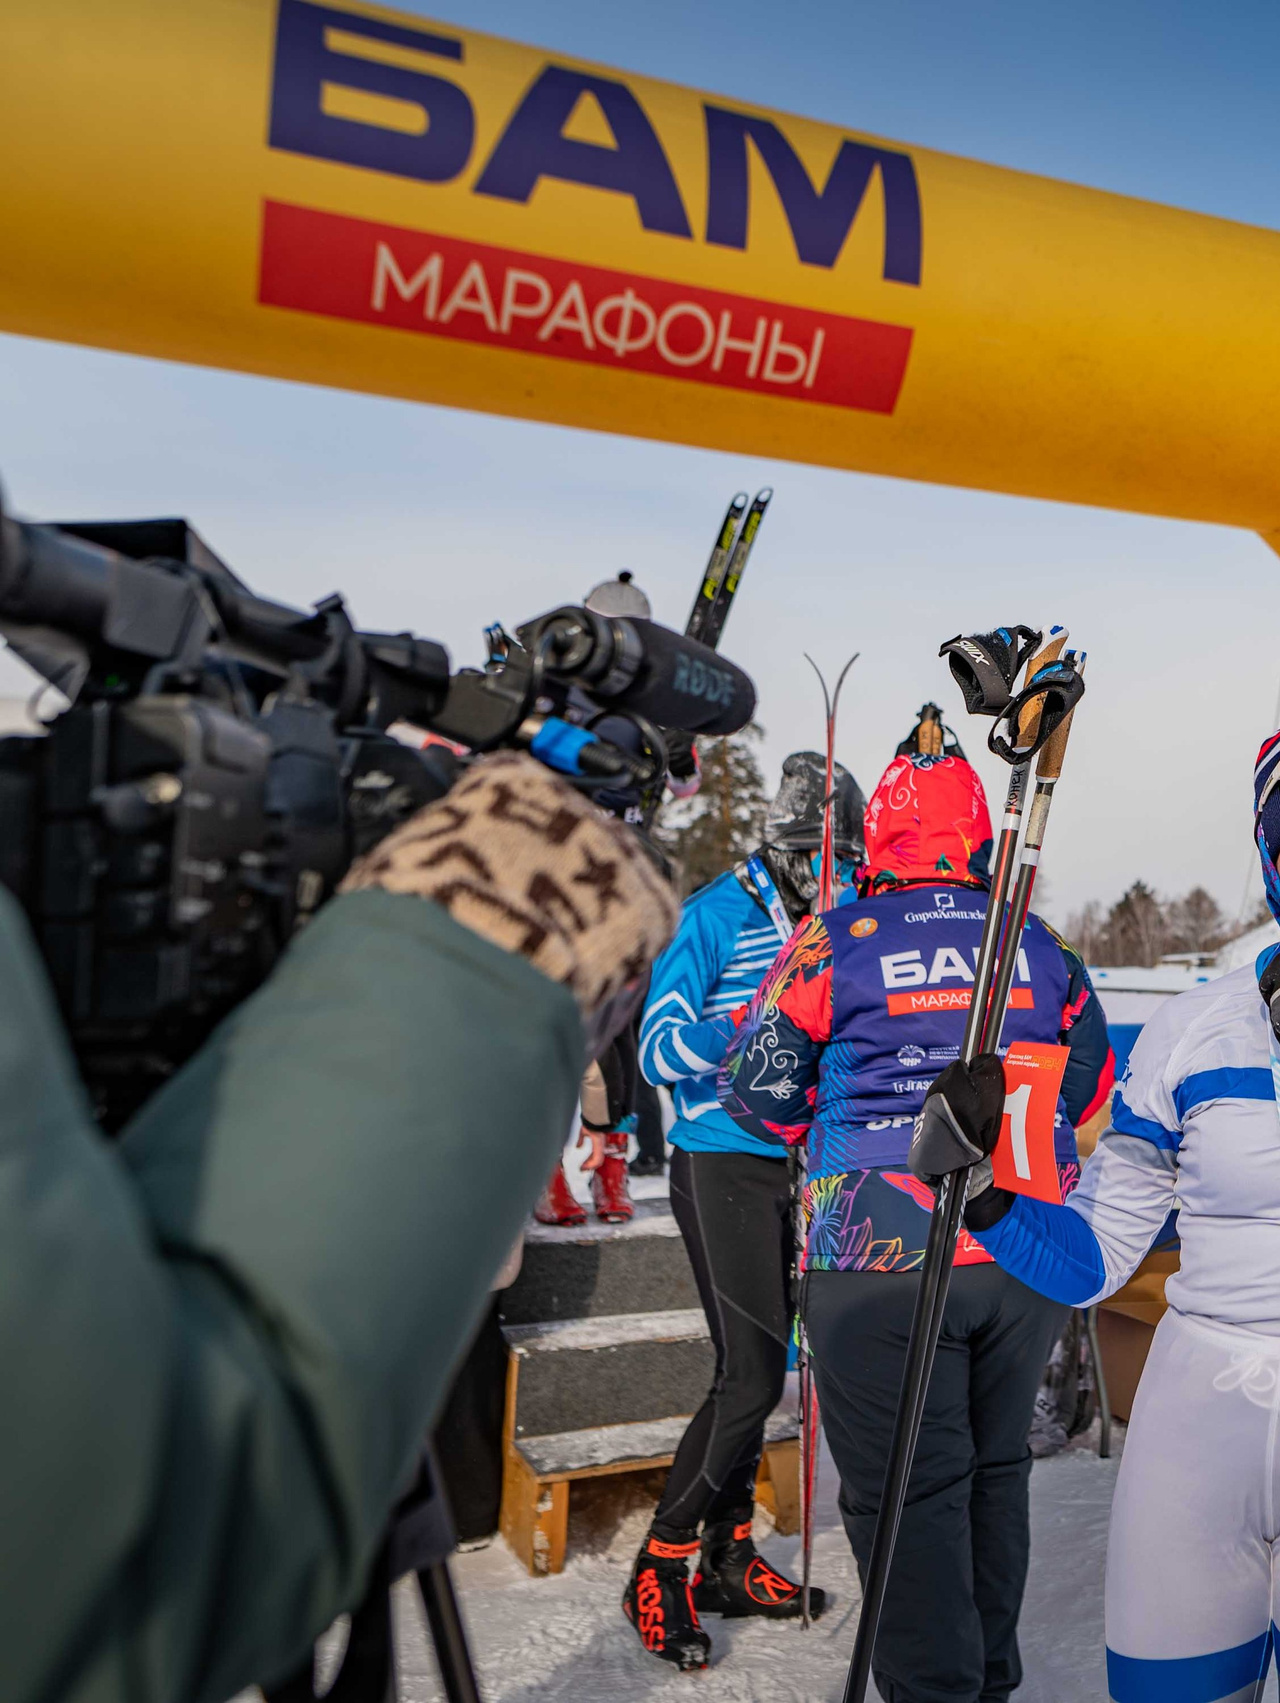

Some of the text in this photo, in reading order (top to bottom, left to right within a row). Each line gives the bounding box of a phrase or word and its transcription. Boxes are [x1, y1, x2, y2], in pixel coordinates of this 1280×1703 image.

[267, 0, 923, 288] БАМ
[371, 241, 825, 389] МАРАФОНЫ
[956, 640, 990, 666] SWIX
[1003, 1083, 1033, 1181] 1
